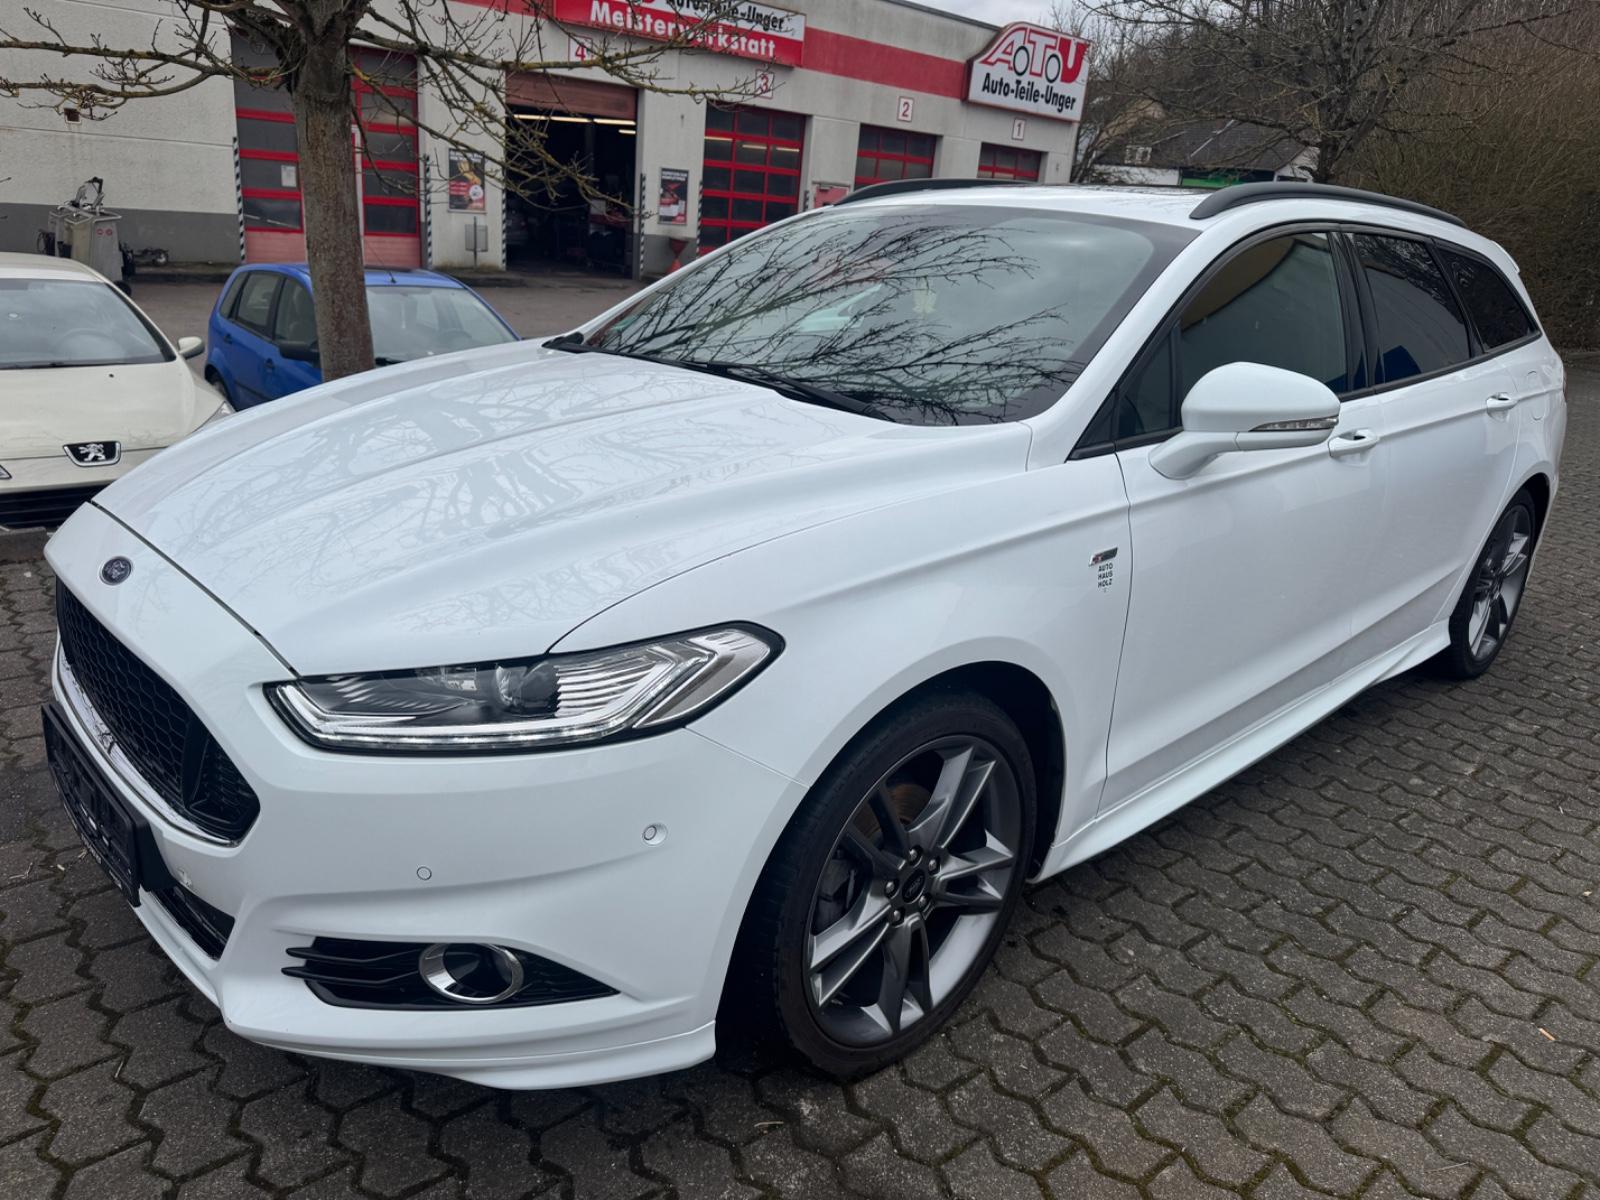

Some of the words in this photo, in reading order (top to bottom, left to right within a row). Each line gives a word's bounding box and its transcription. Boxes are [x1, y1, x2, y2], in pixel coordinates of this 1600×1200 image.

[574, 43, 587, 62] 4
[760, 74, 769, 94] 3
[982, 72, 1076, 113] Auto-Teile-Unger
[902, 102, 910, 117] 2
